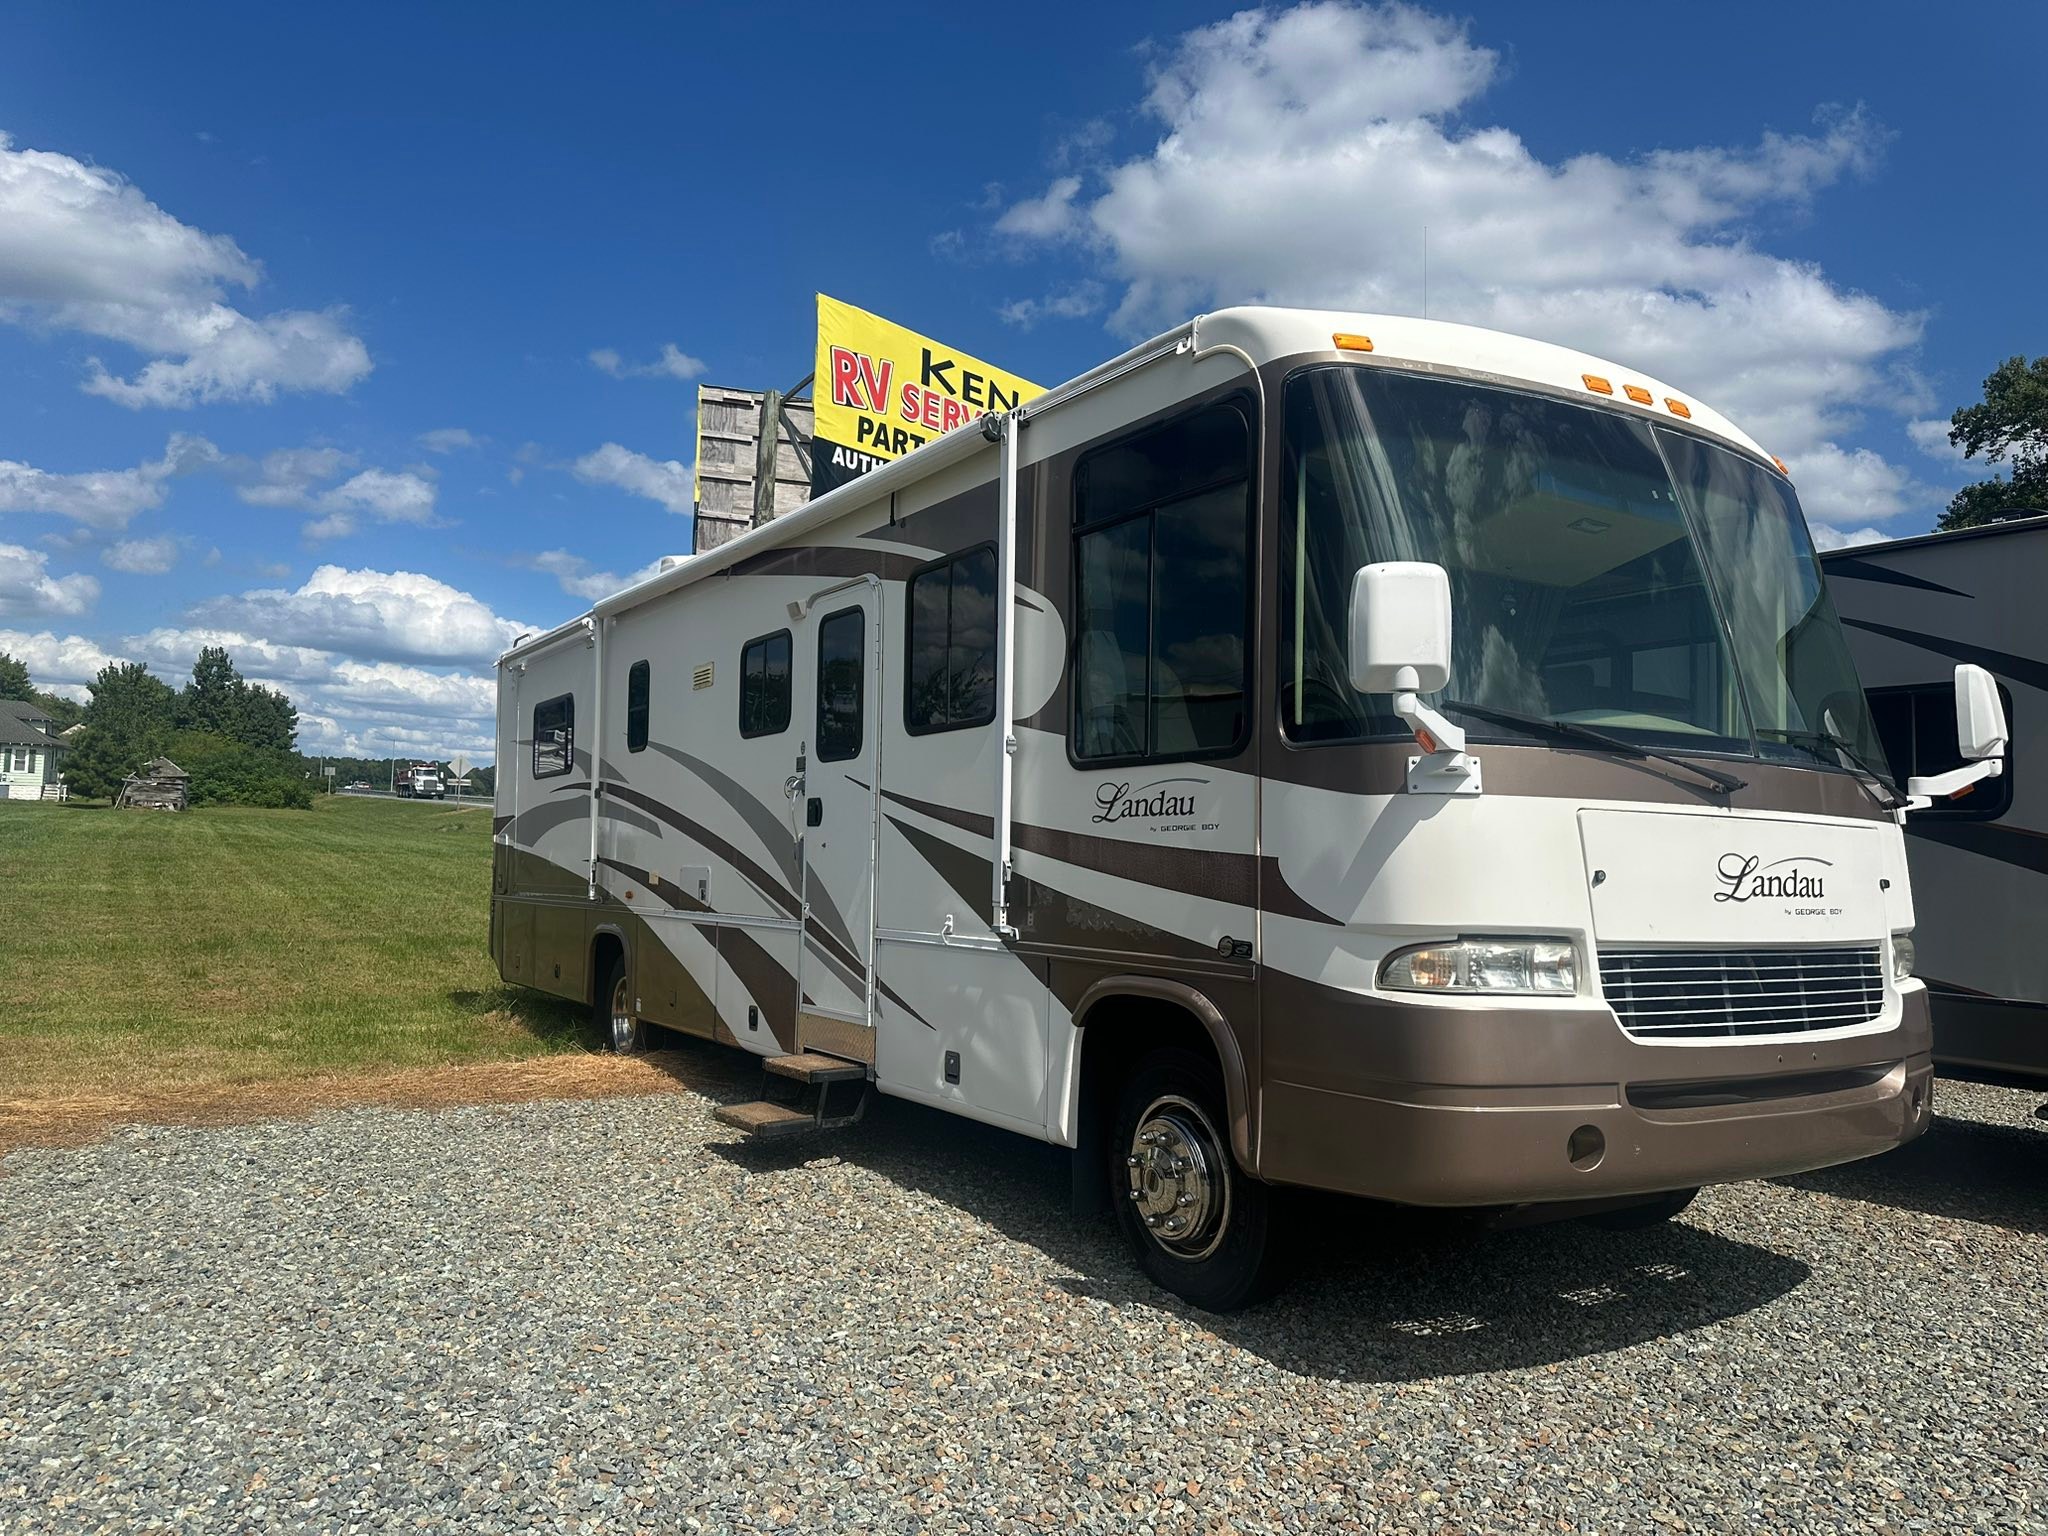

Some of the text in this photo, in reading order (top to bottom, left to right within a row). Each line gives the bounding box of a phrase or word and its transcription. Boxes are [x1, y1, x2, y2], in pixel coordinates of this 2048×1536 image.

[830, 344, 894, 415] RV
[921, 347, 1019, 411] KEN
[857, 415, 932, 456] PART
[1091, 782, 1196, 823] Landau
[1160, 824, 1197, 832] GEORGIE
[1201, 823, 1220, 831] BOY
[1713, 852, 1825, 903] Landau
